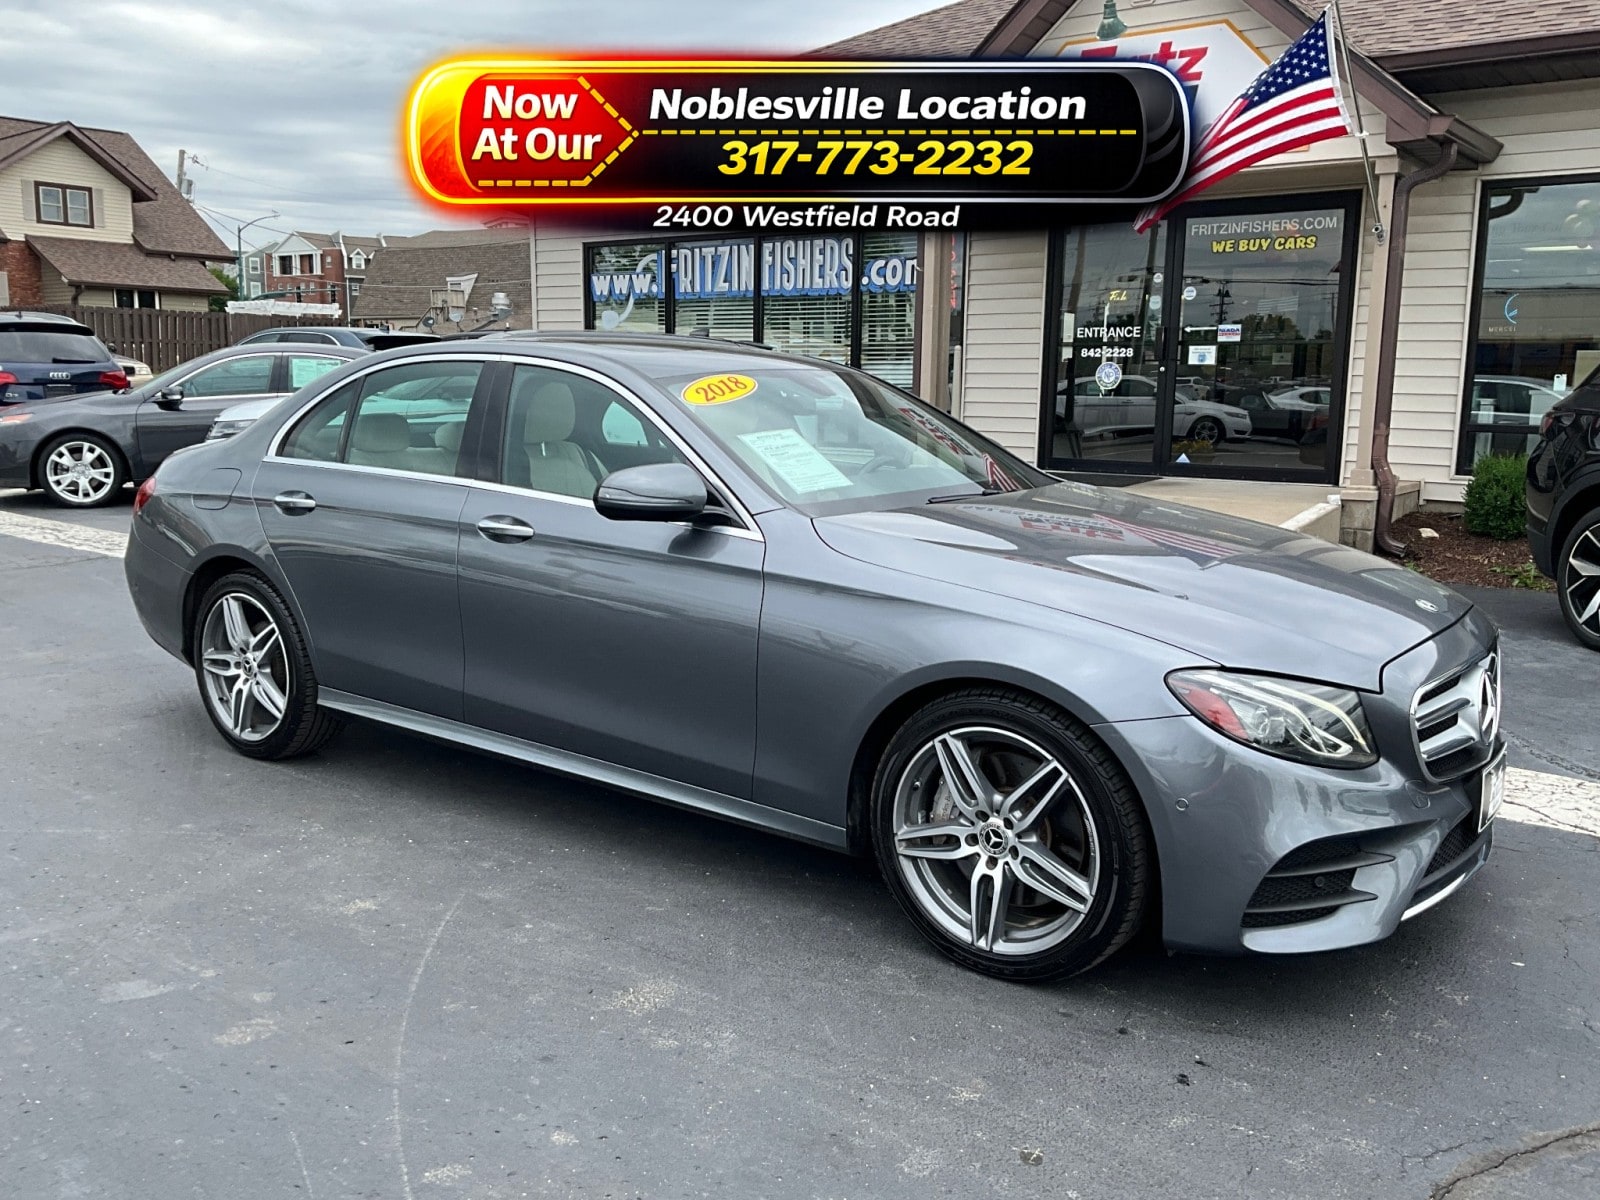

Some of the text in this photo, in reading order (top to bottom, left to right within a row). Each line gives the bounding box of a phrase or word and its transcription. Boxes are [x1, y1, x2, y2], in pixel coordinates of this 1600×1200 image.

[1191, 216, 1338, 236] FRITZINFISHERS.COM
[1211, 236, 1317, 253] WE BUY CARS
[762, 238, 853, 292] FISHERS
[1076, 327, 1141, 338] ENTRANCE
[1081, 348, 1134, 358] 842-2228
[695, 376, 748, 402] 2018
